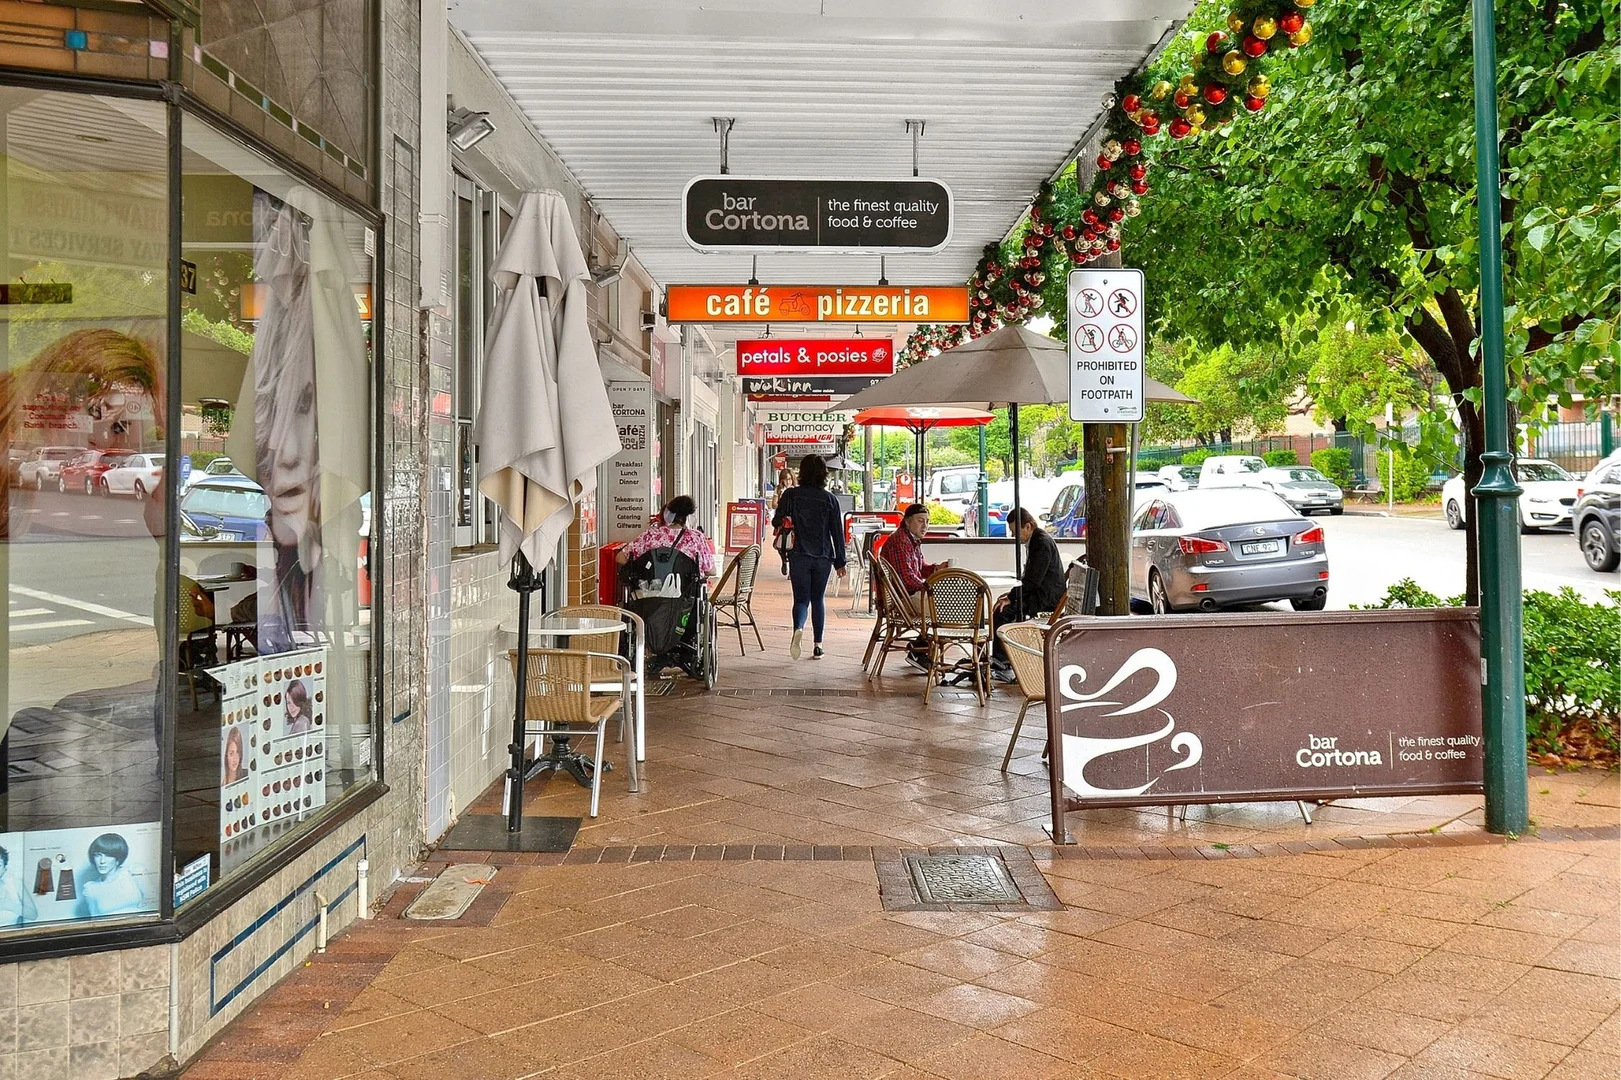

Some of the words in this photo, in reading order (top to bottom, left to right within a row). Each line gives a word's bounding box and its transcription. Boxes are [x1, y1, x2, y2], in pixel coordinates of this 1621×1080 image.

[722, 192, 757, 211] bar
[827, 199, 850, 212] the
[853, 198, 891, 212] finest
[893, 199, 939, 215] quality
[705, 209, 810, 231] Cortona
[827, 215, 860, 229] food
[863, 216, 873, 228] &
[876, 215, 918, 229] coffee
[706, 287, 770, 316] café
[817, 288, 930, 321] pizzeria
[741, 347, 791, 367] petals
[797, 347, 811, 363] &
[816, 348, 868, 366] posies
[1076, 361, 1138, 371] PROHIBITED
[1099, 375, 1115, 386] ON
[1081, 389, 1133, 400] FOOTPATH
[767, 412, 847, 422] BUTCHER
[615, 424, 639, 436] afé
[780, 423, 835, 433] pharmacy
[1309, 733, 1338, 750] bar
[1398, 736, 1415, 747] the
[1417, 735, 1445, 747] finest
[1447, 734, 1481, 748] quality
[1295, 749, 1382, 768] Cortona
[1399, 750, 1423, 762] food
[1424, 750, 1433, 760] &
[1435, 748, 1467, 760] coffee
